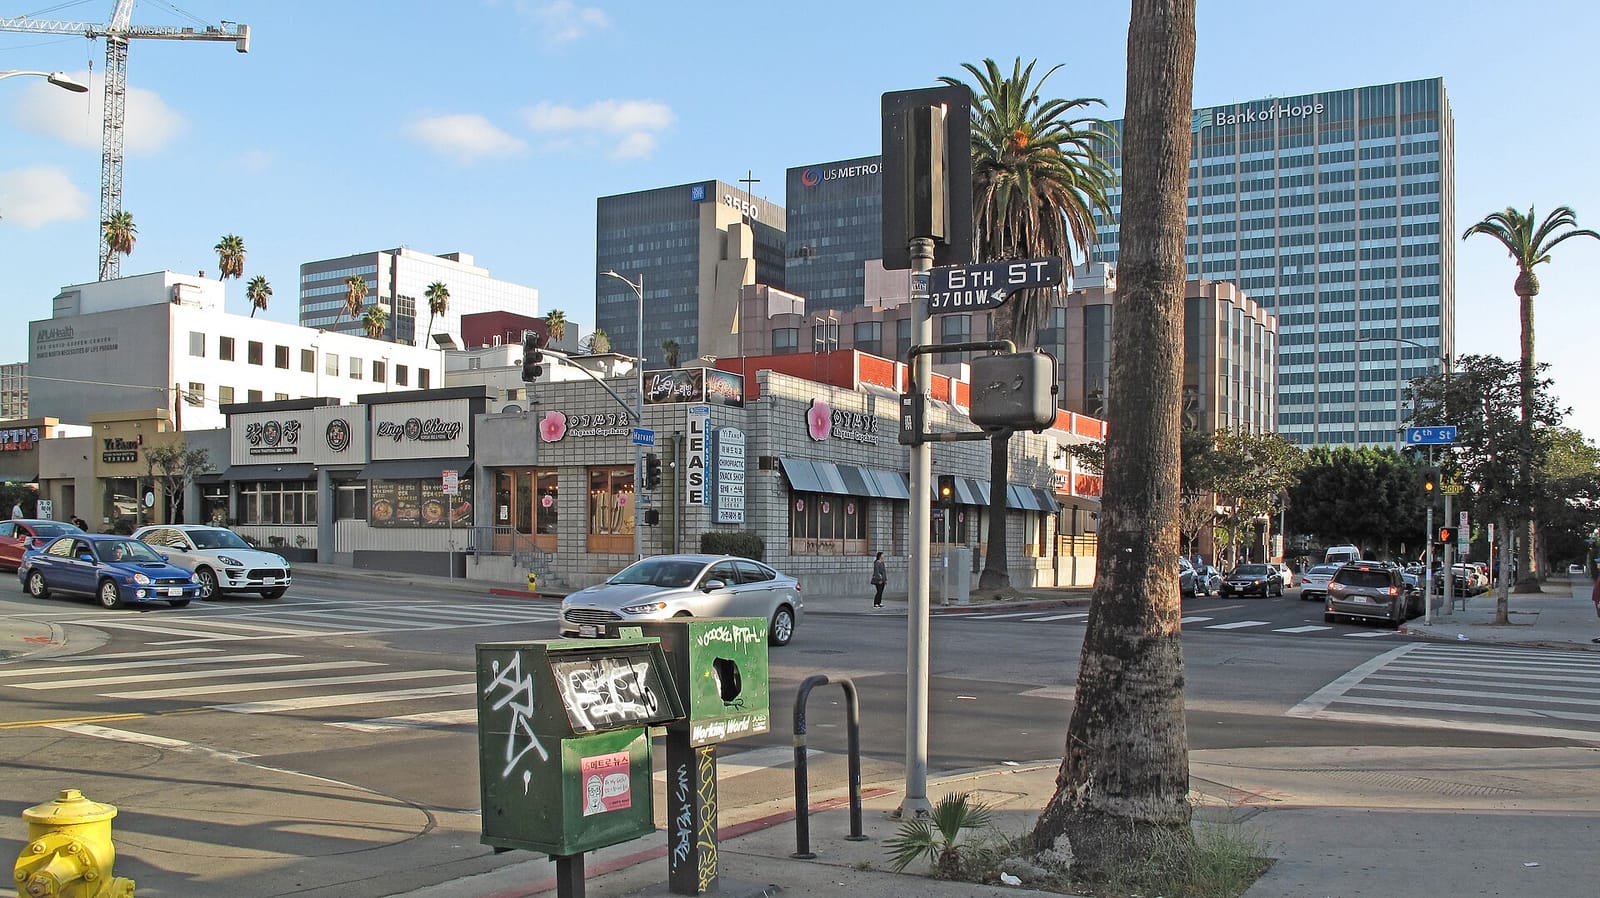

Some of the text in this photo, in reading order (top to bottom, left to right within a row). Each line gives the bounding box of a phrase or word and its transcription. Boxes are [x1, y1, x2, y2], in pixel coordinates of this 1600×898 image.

[1216, 103, 1324, 126] Bank of Hope
[724, 194, 758, 220] 3550
[948, 269, 993, 289] 6TH
[1008, 261, 1050, 284] ST.
[376, 420, 404, 442] King
[633, 430, 655, 443] Harvard
[1412, 429, 1451, 442] 6th St
[689, 420, 704, 504] LEASE
[693, 721, 725, 740] Working
[726, 715, 750, 734] World
